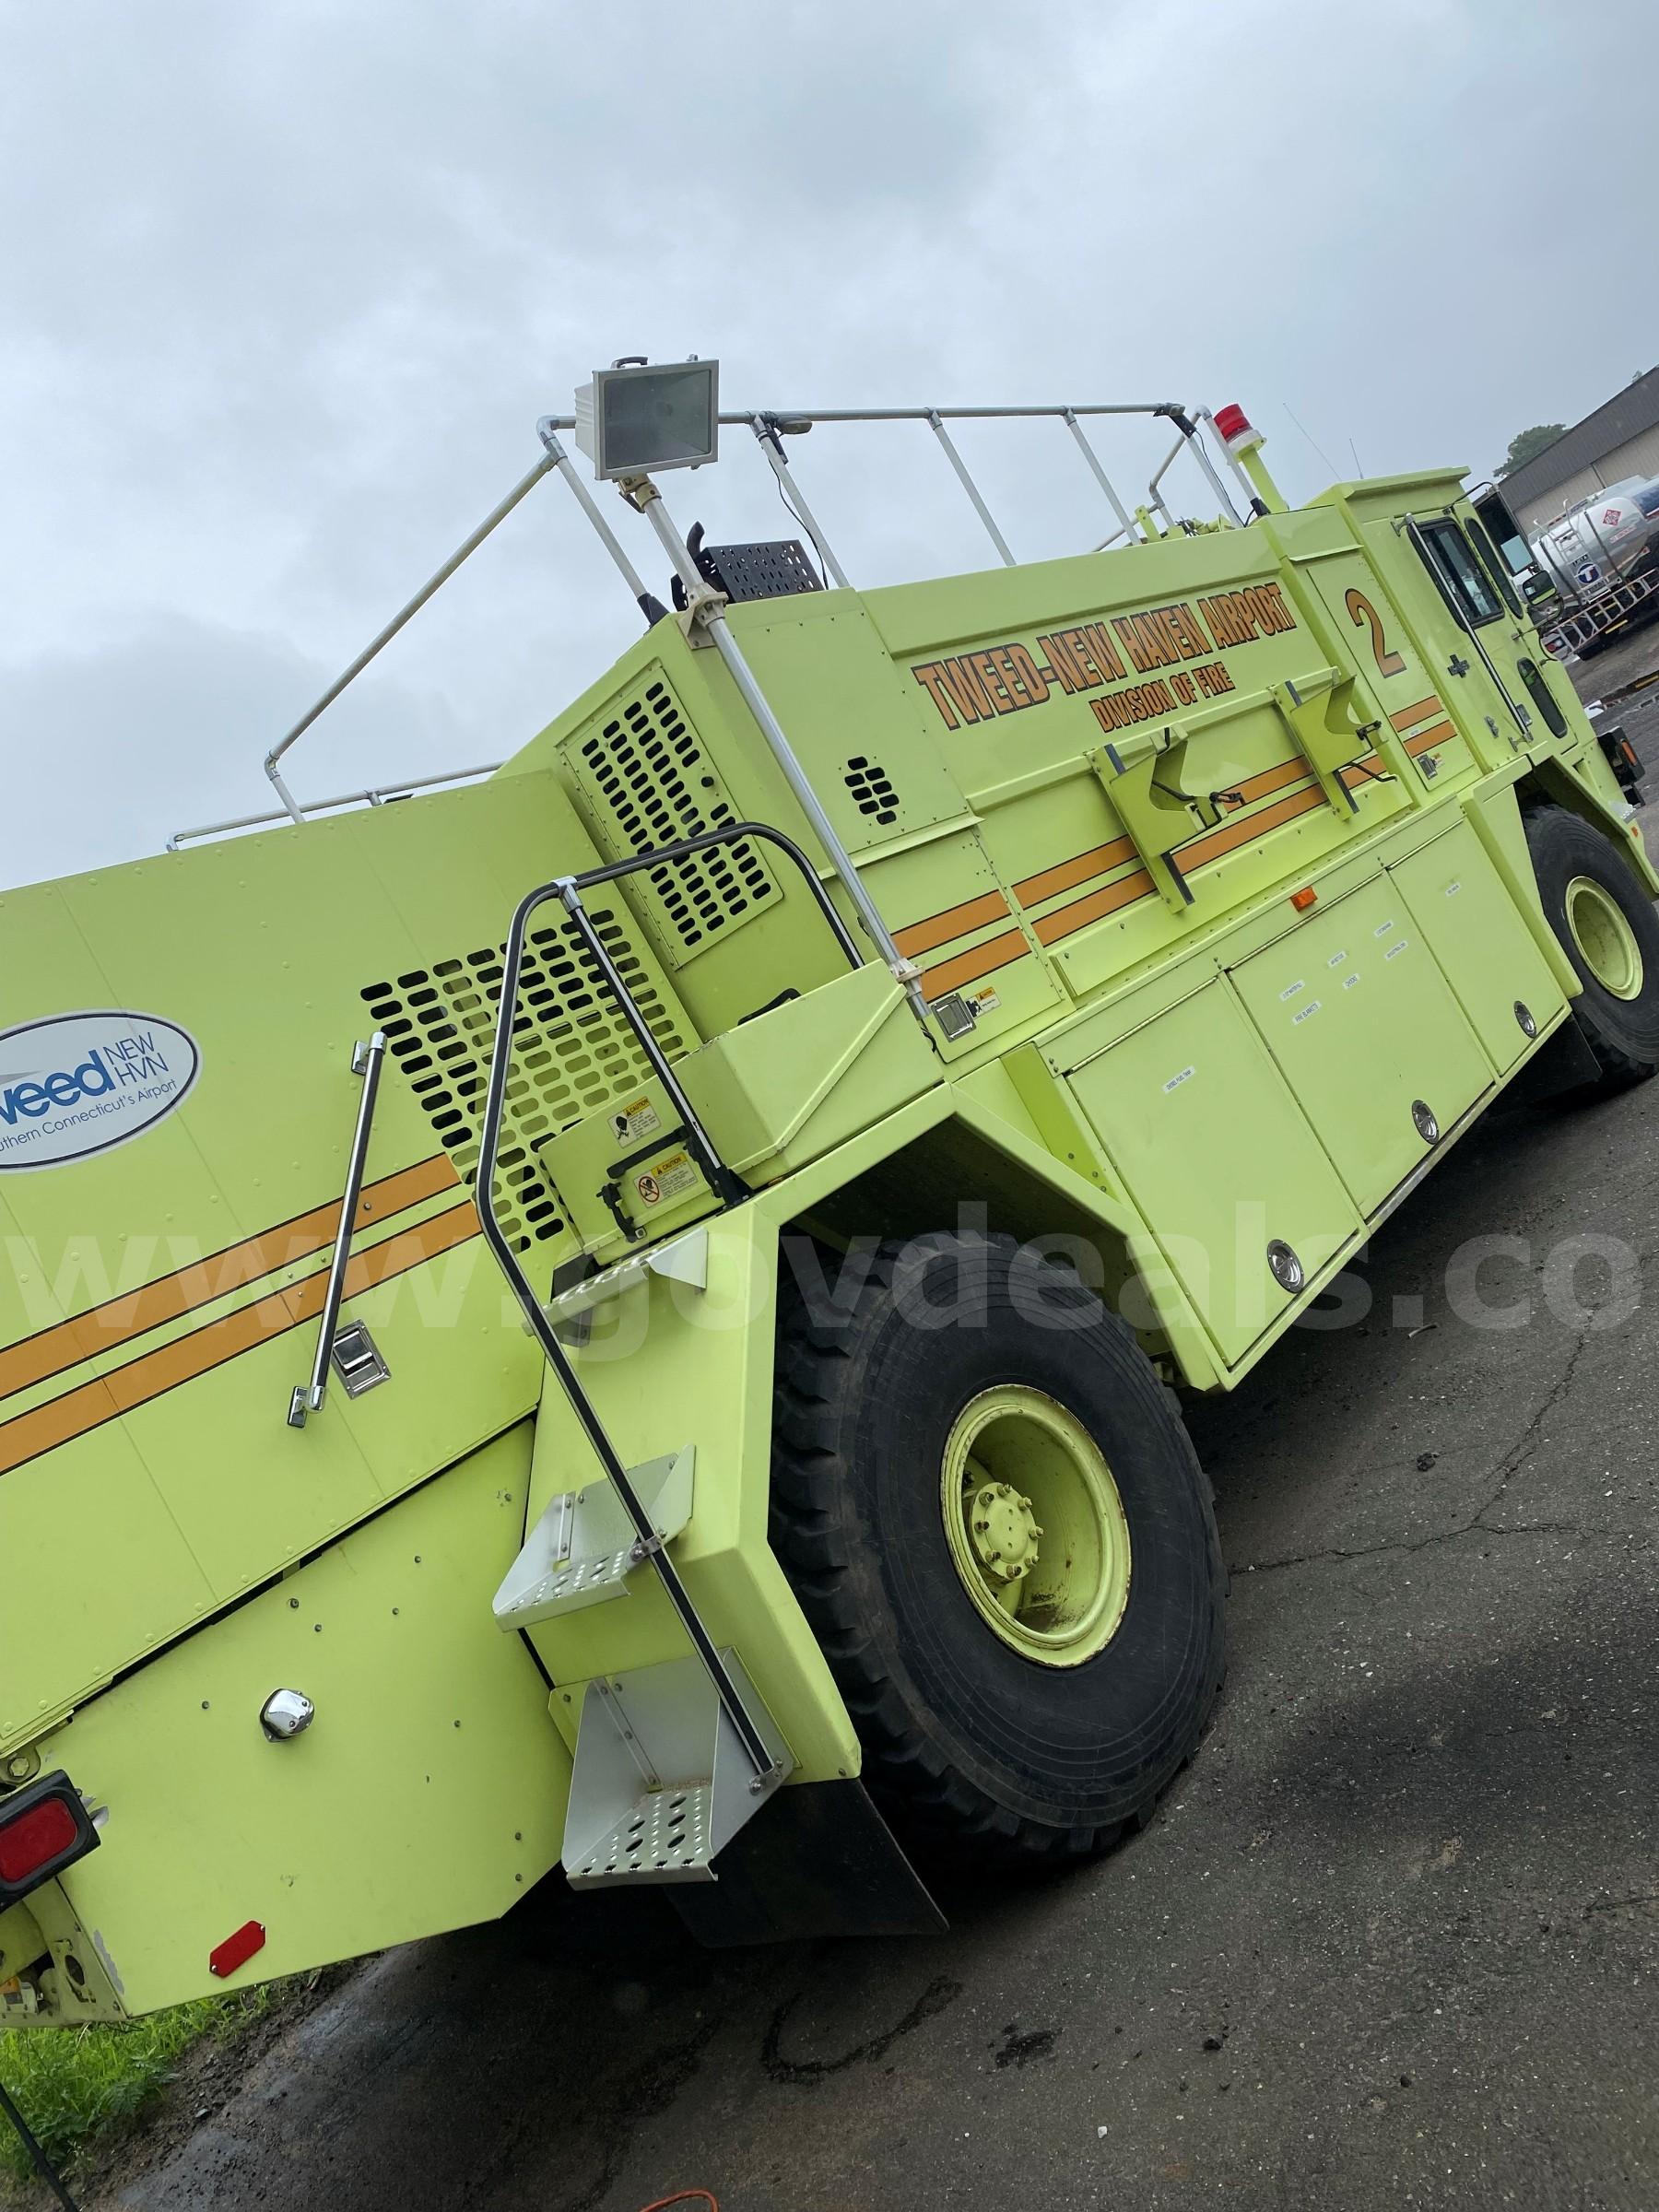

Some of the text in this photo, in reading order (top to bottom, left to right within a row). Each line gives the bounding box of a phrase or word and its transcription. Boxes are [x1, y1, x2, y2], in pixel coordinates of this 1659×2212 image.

[1344, 587, 1407, 678] 2
[912, 582, 1297, 732] TWEED-NEW HAVEN AIRPORT
[1089, 661, 1235, 734] DIVISION OF FIRE
[102, 1031, 155, 1065] NEW
[114, 1053, 170, 1087] HVN
[41, 1094, 135, 1135] Connecticut's
[137, 1078, 177, 1106] Airport
[629, 1098, 649, 1113] CAUTION
[662, 1156, 682, 1171] CAUTION
